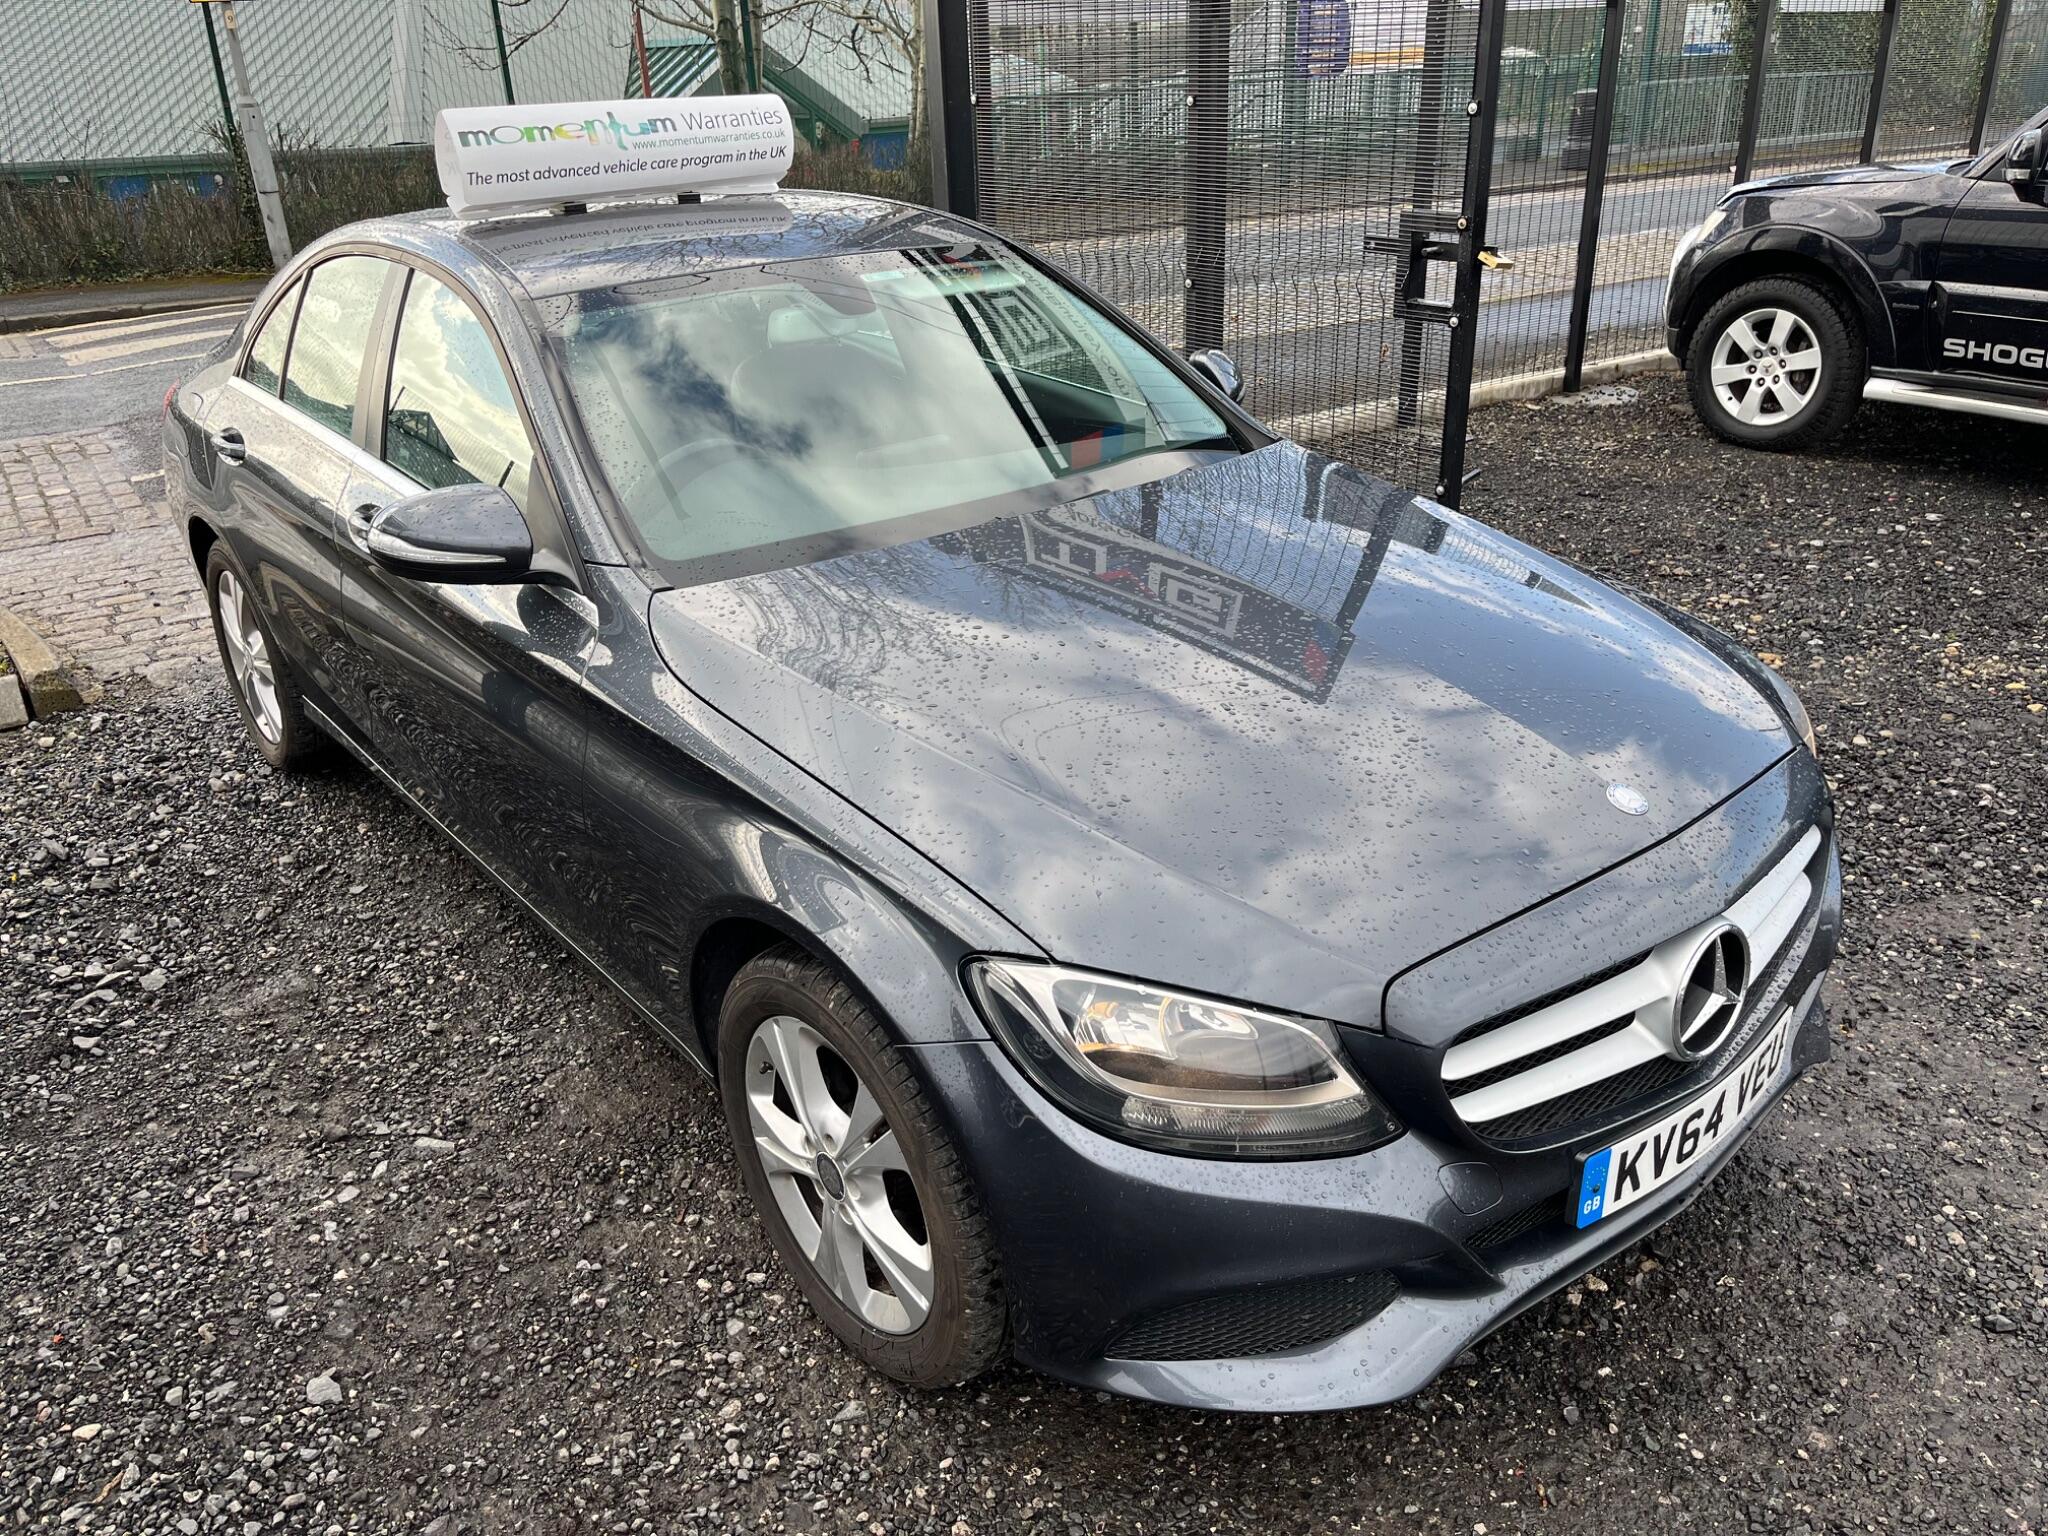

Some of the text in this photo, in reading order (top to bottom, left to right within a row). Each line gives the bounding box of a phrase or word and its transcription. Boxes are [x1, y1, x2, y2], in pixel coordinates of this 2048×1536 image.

[457, 107, 783, 150] momentum Warranties
[632, 129, 786, 150] www.momentumwarranties.co.uk
[467, 146, 787, 186] The most advanced vehicle care program in the UK
[1943, 338, 2048, 369] SHOG
[1613, 1089, 1726, 1203] KV64
[1584, 1196, 1600, 1214] GB
